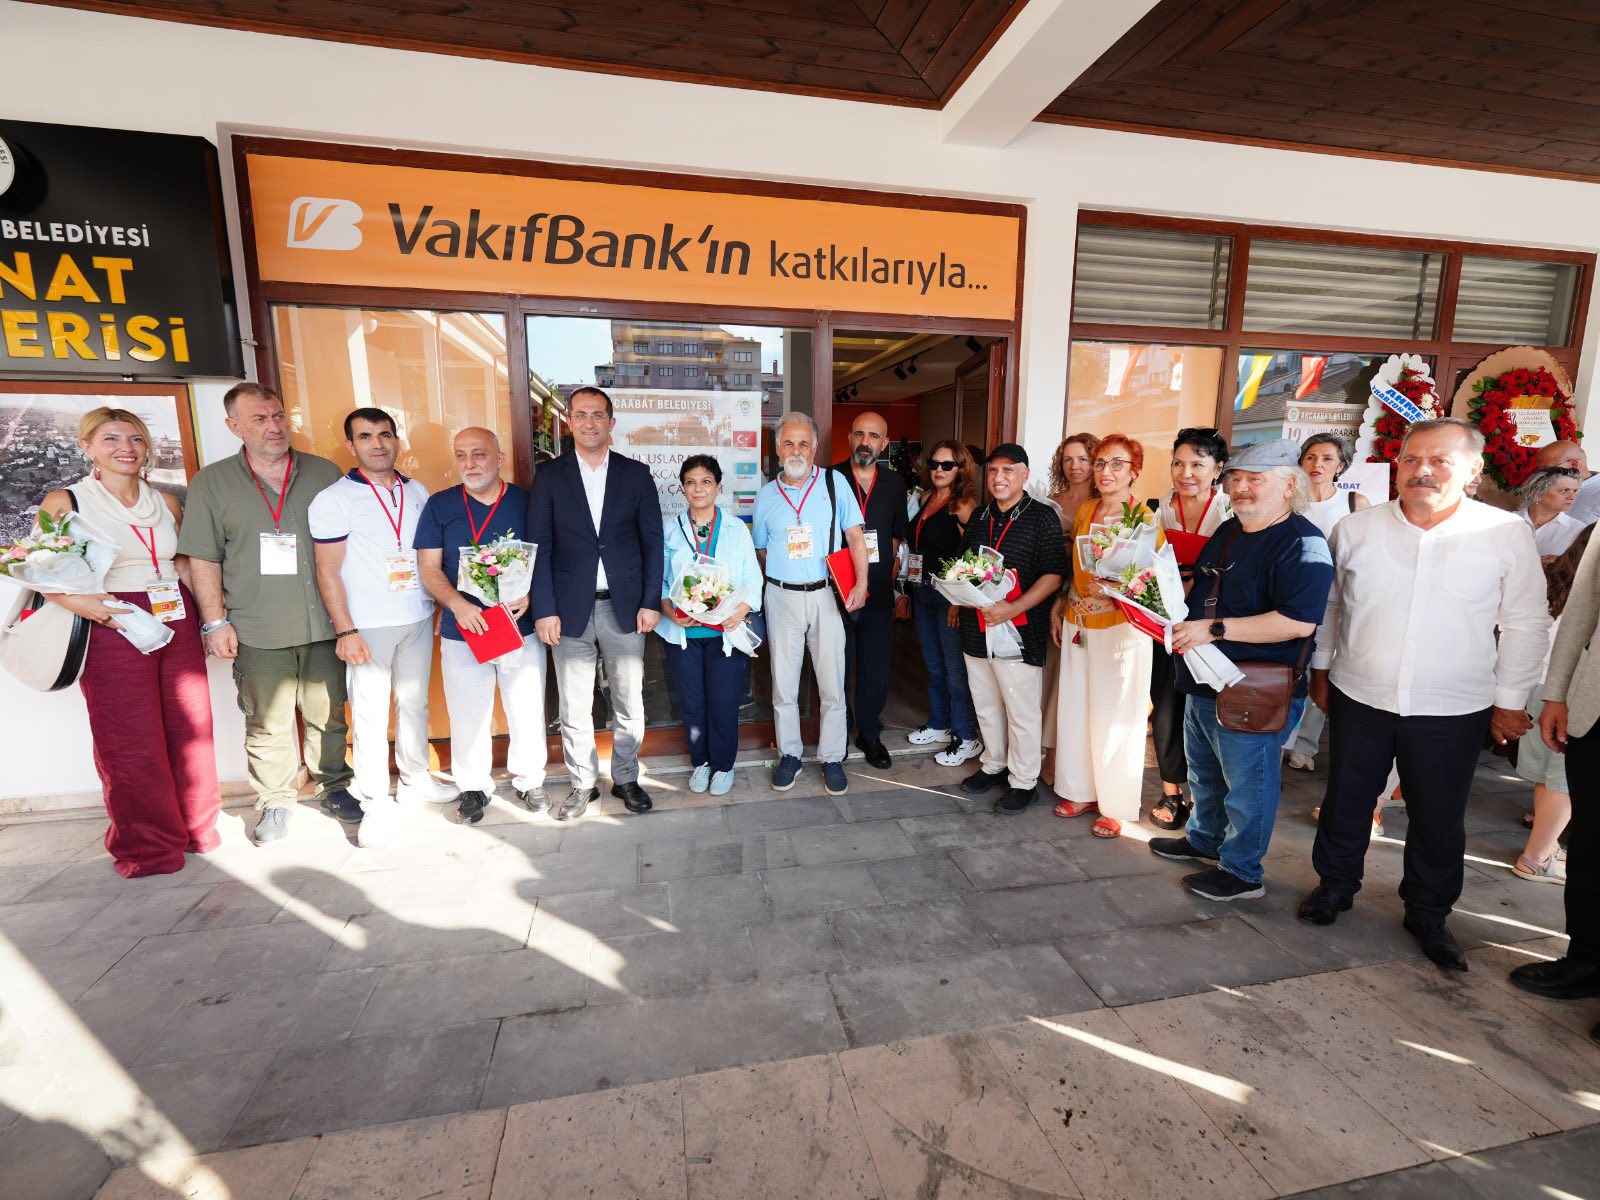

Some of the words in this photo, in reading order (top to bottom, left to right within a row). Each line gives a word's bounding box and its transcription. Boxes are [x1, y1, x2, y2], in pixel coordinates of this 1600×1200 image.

[0, 219, 150, 247] BELEDİYESİ
[769, 239, 989, 296] katkılarıyla...
[0, 309, 190, 363] ERİSİ
